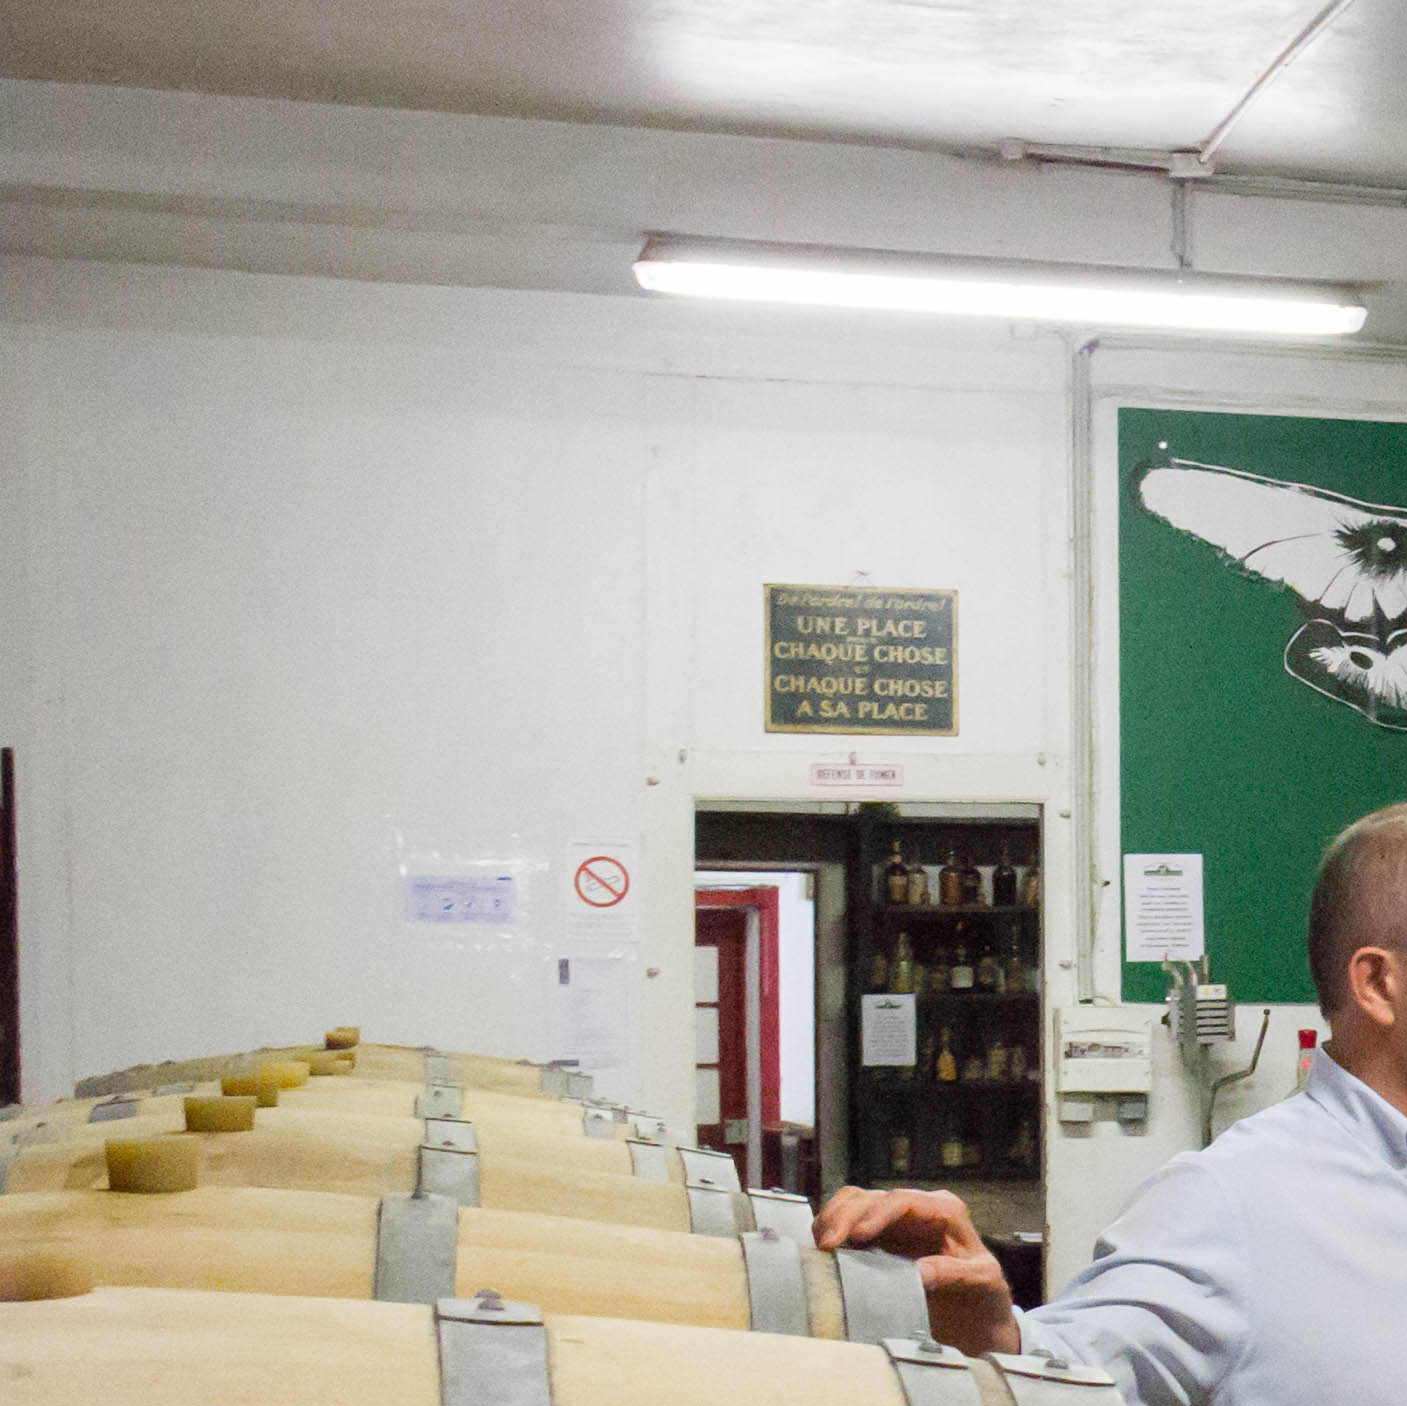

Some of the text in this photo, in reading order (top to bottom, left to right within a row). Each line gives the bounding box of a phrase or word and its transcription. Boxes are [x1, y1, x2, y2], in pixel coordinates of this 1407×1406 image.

[797, 616, 927, 638] UNE PLACE
[774, 641, 948, 665] CHAQUE CHOSE
[774, 675, 948, 698] CHAQUE CHOSE
[797, 700, 928, 721] A SA PLACE
